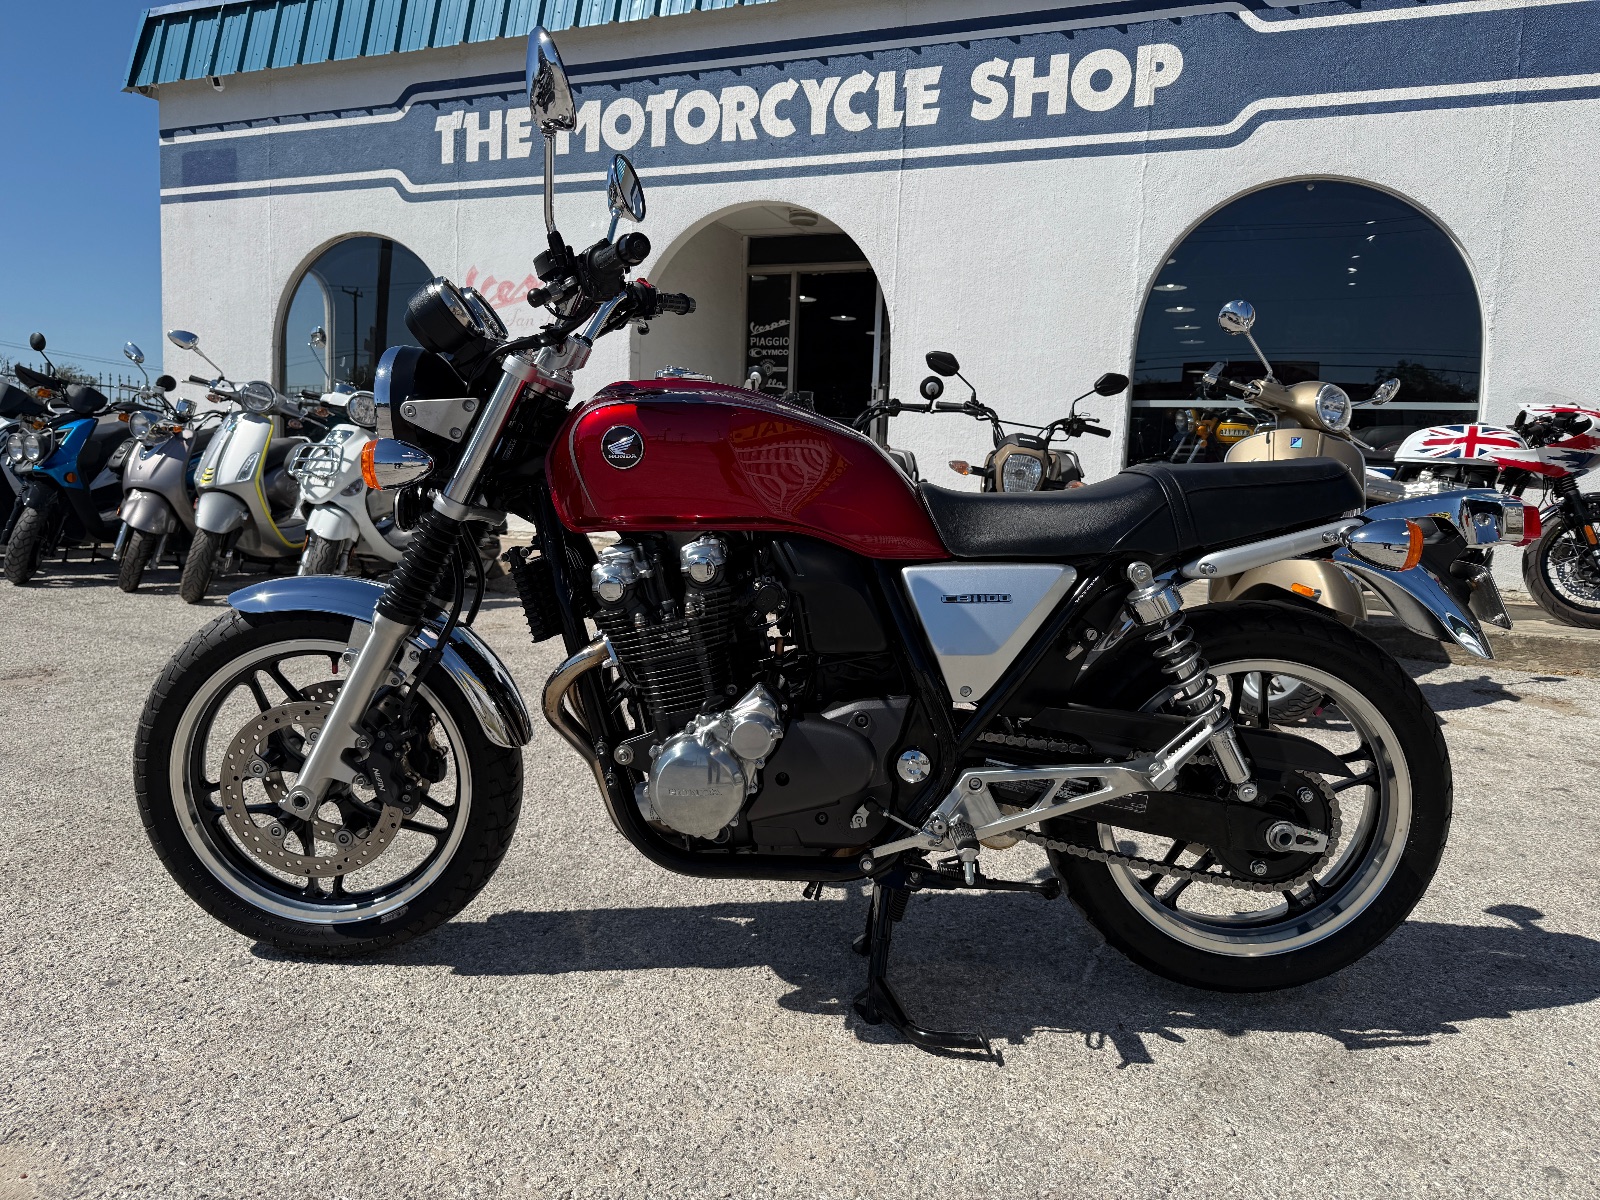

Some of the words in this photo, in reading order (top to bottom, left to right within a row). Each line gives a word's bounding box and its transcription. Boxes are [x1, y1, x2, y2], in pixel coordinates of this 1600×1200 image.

[435, 107, 534, 164] THE
[555, 66, 943, 155] MOTORCYCLE
[971, 43, 1183, 121] SHOP
[750, 319, 790, 336] Vespa
[750, 337, 790, 347] PIAGGIO
[941, 593, 1012, 604] CB1100
[668, 788, 722, 796] HONDA
